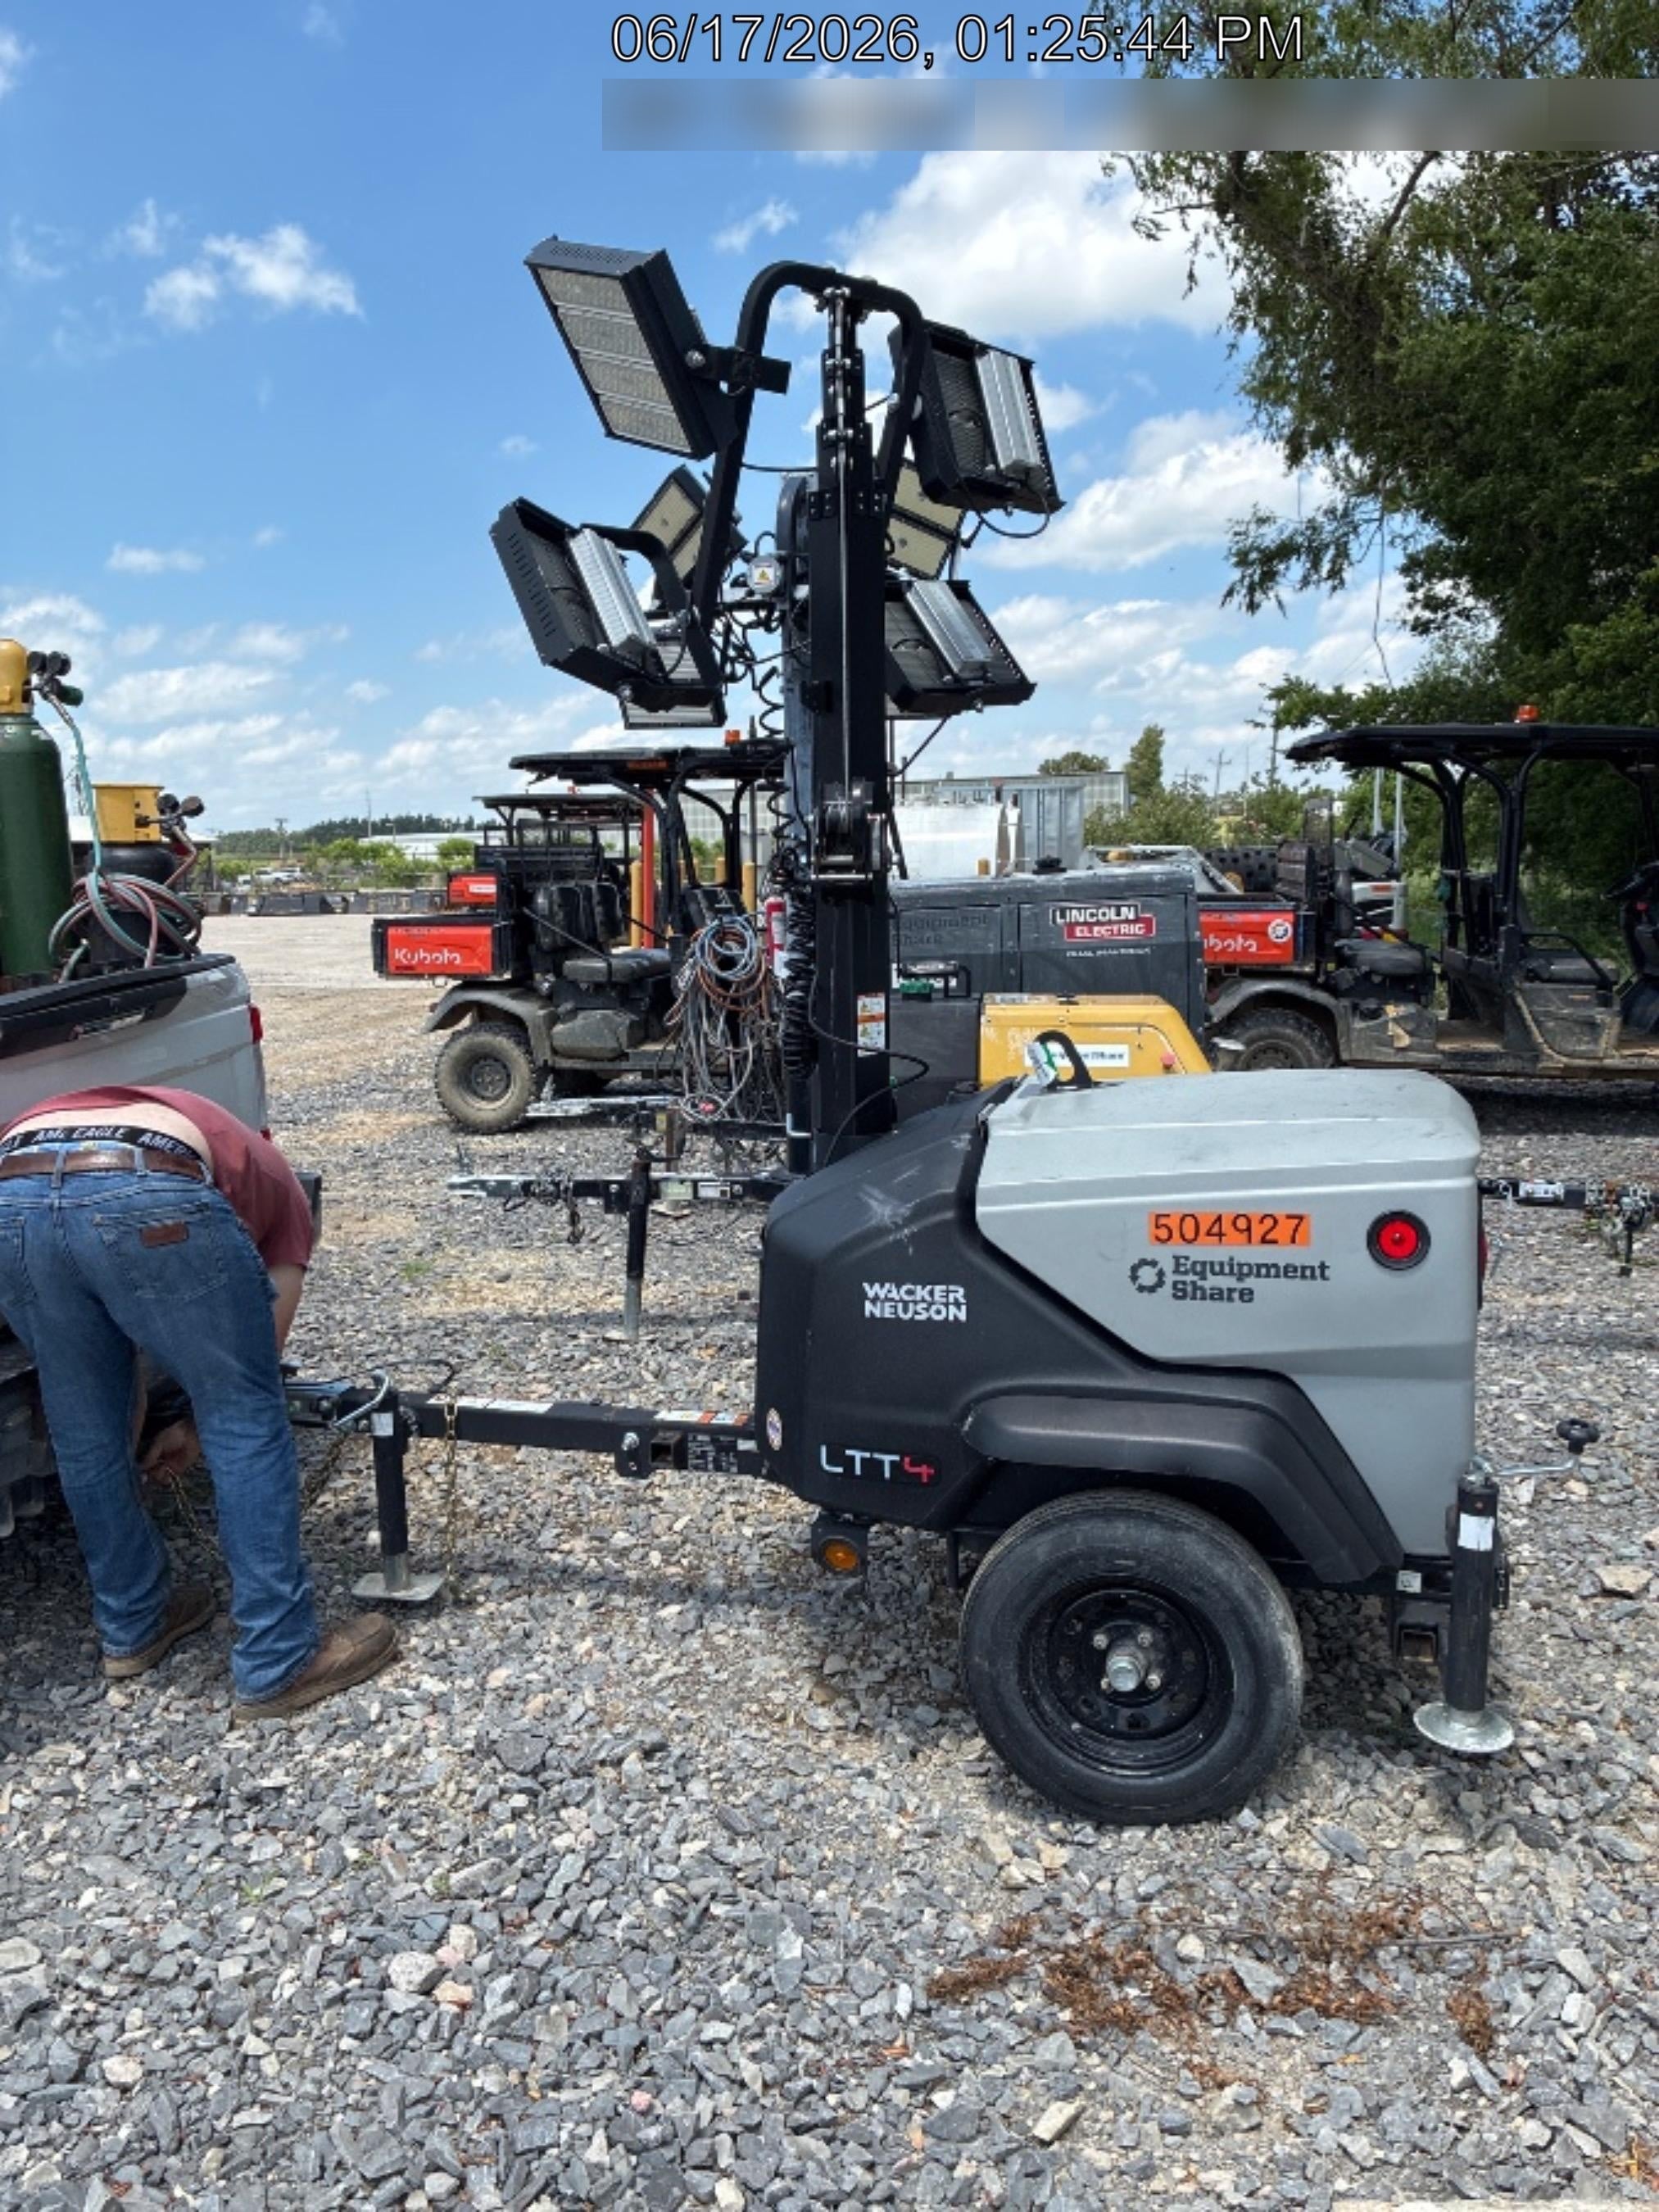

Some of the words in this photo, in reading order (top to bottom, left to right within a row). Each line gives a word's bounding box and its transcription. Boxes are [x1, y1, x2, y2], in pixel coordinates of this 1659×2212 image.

[1055, 905, 1136, 926] LINCOLN
[1074, 923, 1146, 938] ELECTRIC
[394, 948, 461, 964] Kubota
[71, 1126, 129, 1140] EAGLE
[1154, 1213, 1306, 1244] 504927
[1172, 1254, 1330, 1283] Equipment
[862, 1281, 967, 1303] WACKER
[1172, 1280, 1255, 1303] Share
[864, 1299, 968, 1323] NEUSON
[820, 1443, 936, 1484] LTT4
